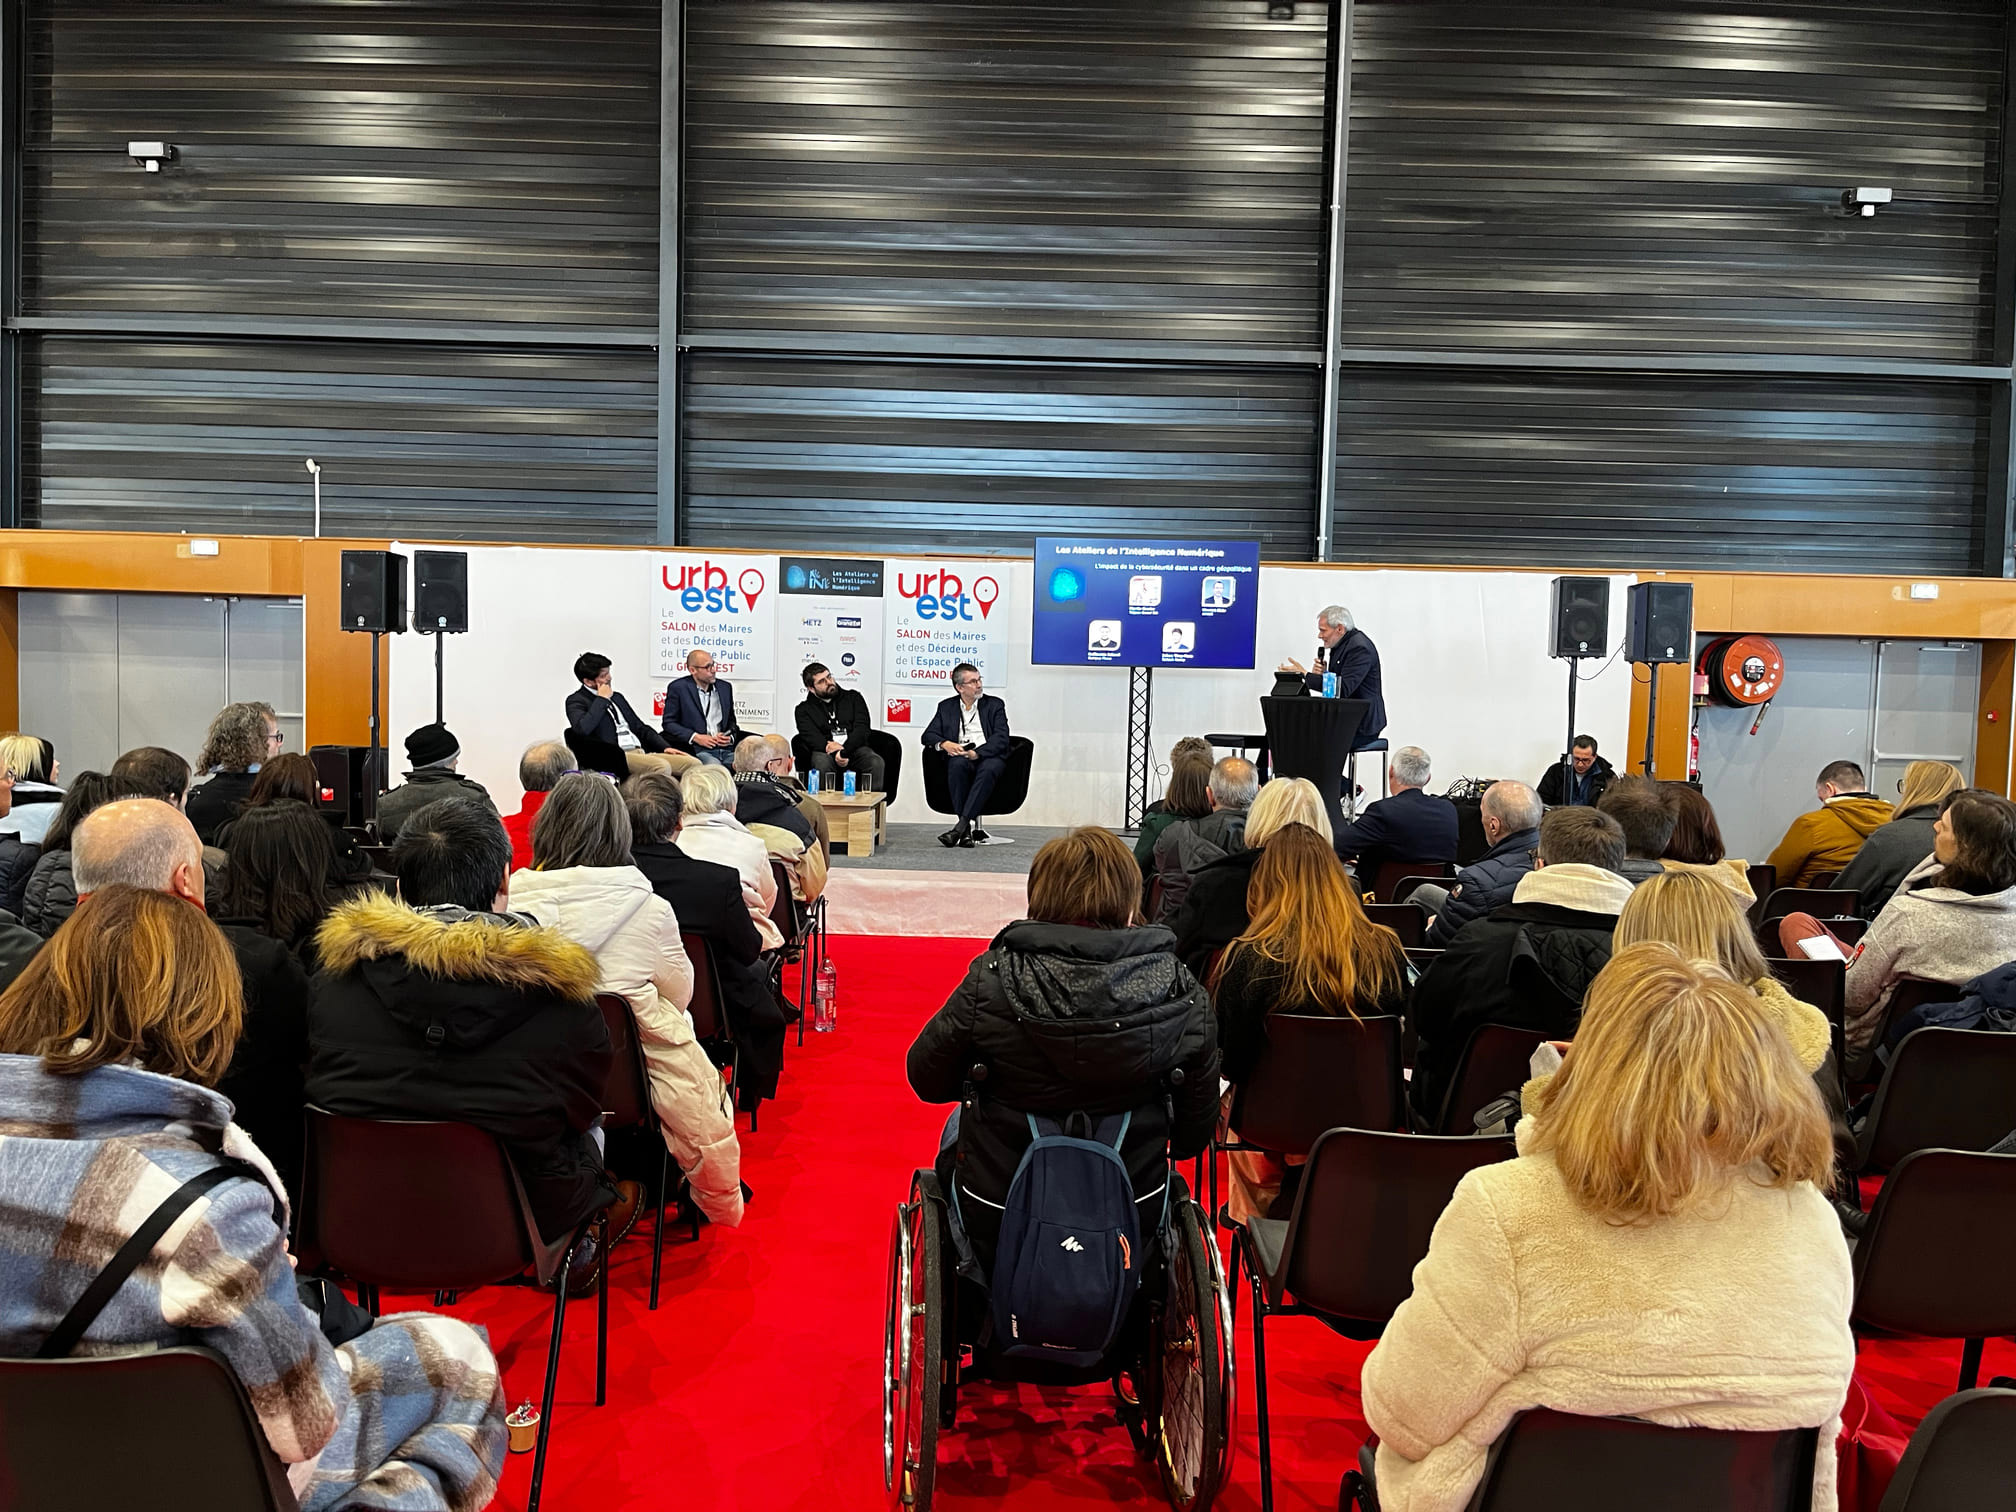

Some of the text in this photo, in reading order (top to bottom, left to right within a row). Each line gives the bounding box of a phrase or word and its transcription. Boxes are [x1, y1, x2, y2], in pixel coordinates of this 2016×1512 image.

[1055, 546, 1225, 558] Les Ateliers de l'Intelligence Numérique
[1135, 564, 1174, 572] cybersécurité
[1216, 565, 1252, 573] géopolitique
[662, 560, 728, 592] urb
[832, 577, 876, 585] l'Intelligence
[832, 584, 860, 592] Numérique
[898, 568, 963, 599] urb
[681, 586, 739, 613] est
[916, 593, 973, 621] est
[661, 608, 674, 618] Le
[896, 616, 909, 625] Le
[661, 621, 753, 634] SALON des Maires
[896, 629, 986, 641] SALON des Maires
[661, 636, 744, 647] et des Décideurs
[896, 643, 978, 654] et des Décideurs
[661, 649, 673, 658] de
[720, 650, 751, 661] Public
[895, 656, 908, 665] de
[910, 656, 951, 667] l'Espace
[661, 663, 673, 672] du
[895, 669, 908, 678] du
[910, 670, 947, 680] GRAND
